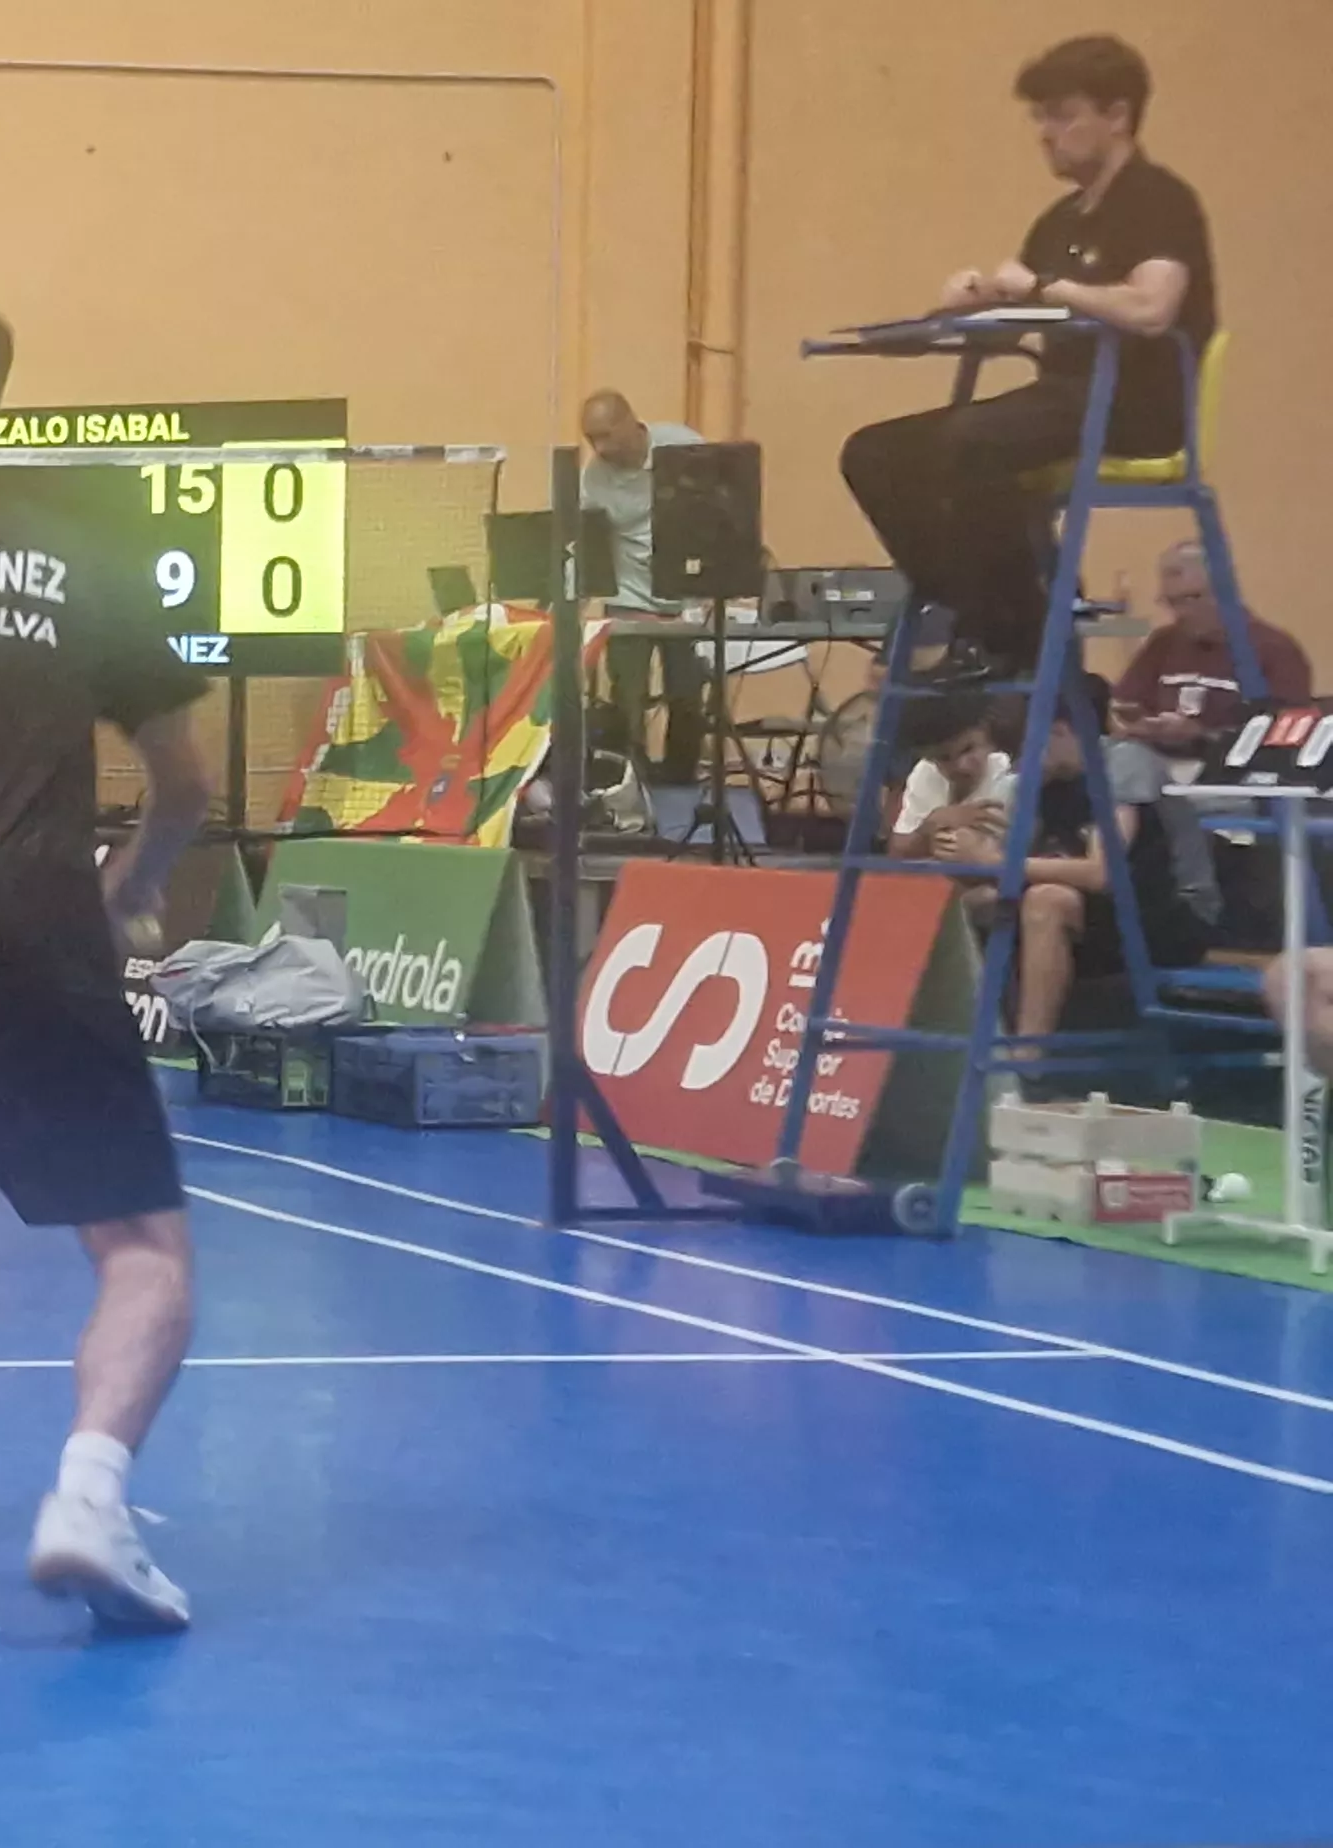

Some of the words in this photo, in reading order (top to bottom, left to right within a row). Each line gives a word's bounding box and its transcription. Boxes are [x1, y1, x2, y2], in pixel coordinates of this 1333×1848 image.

[76, 412, 190, 443] ISABAL
[140, 461, 216, 515] 15
[264, 462, 304, 523] 0
[155, 550, 196, 609] 9
[262, 555, 302, 618] 0
